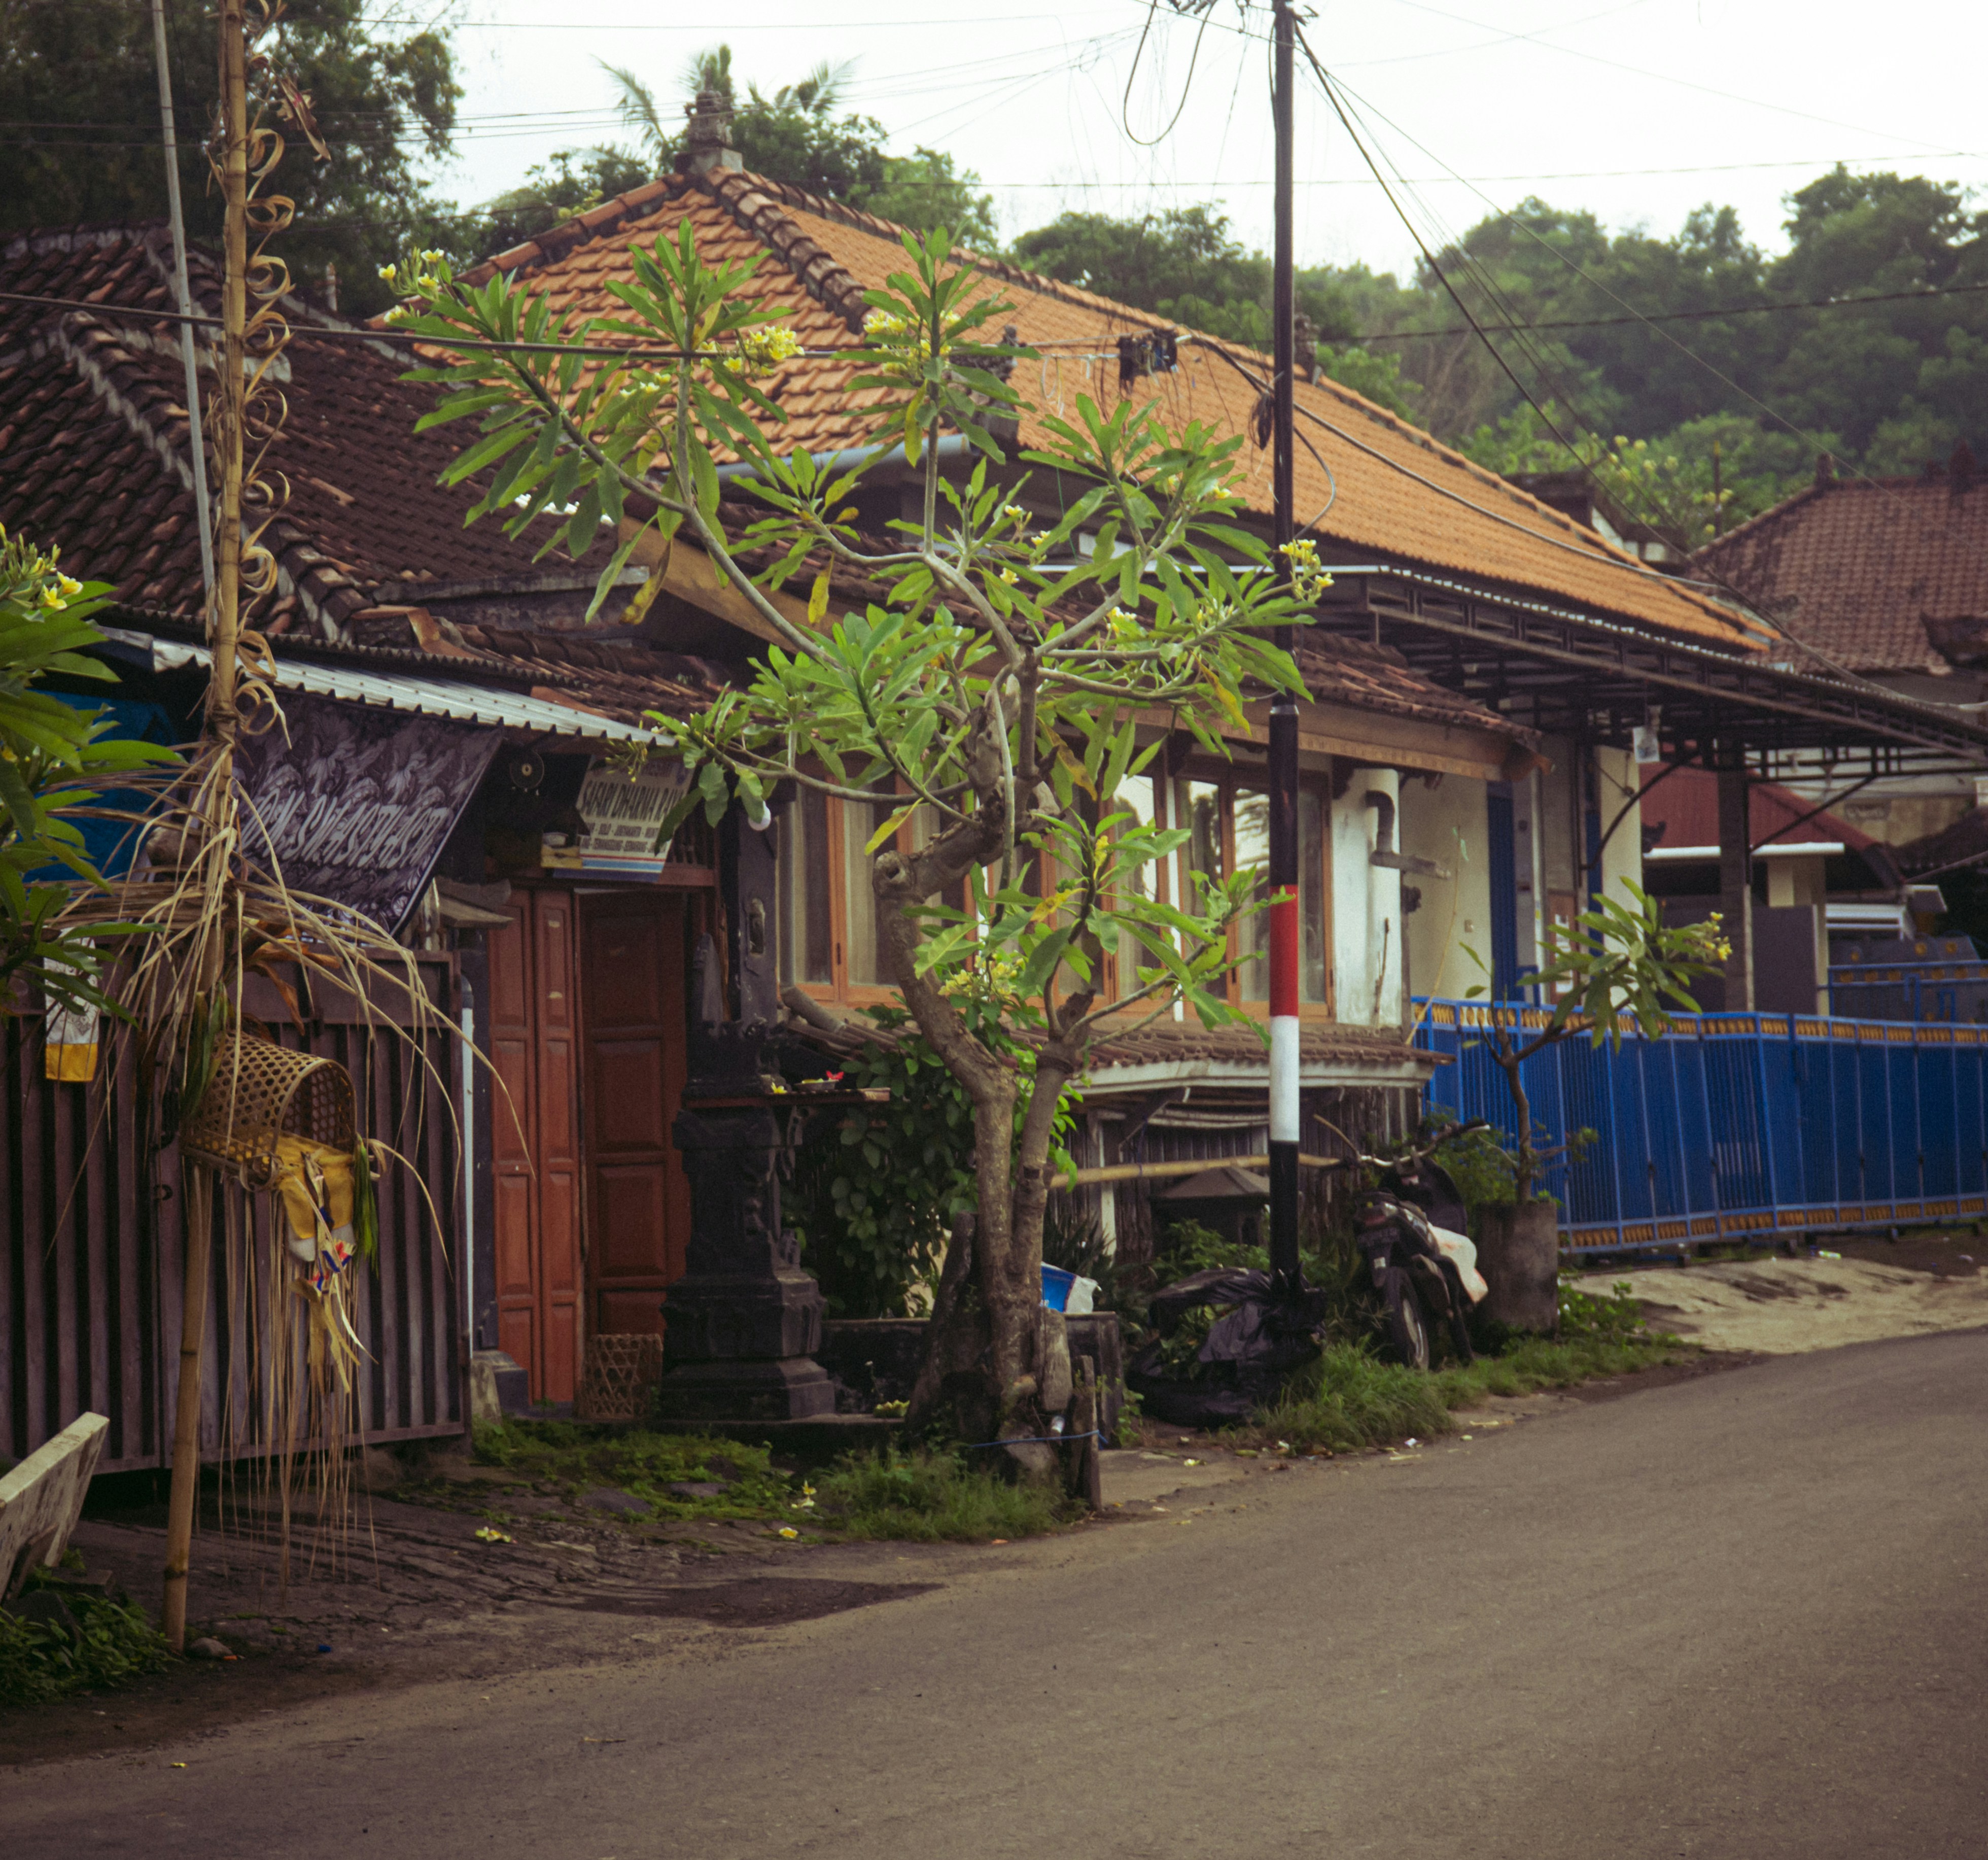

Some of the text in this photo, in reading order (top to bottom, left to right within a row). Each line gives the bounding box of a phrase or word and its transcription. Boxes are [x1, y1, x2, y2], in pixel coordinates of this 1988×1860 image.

[237, 788, 450, 868] OM SWASTYASTU
[610, 783, 659, 821] DHARMA
